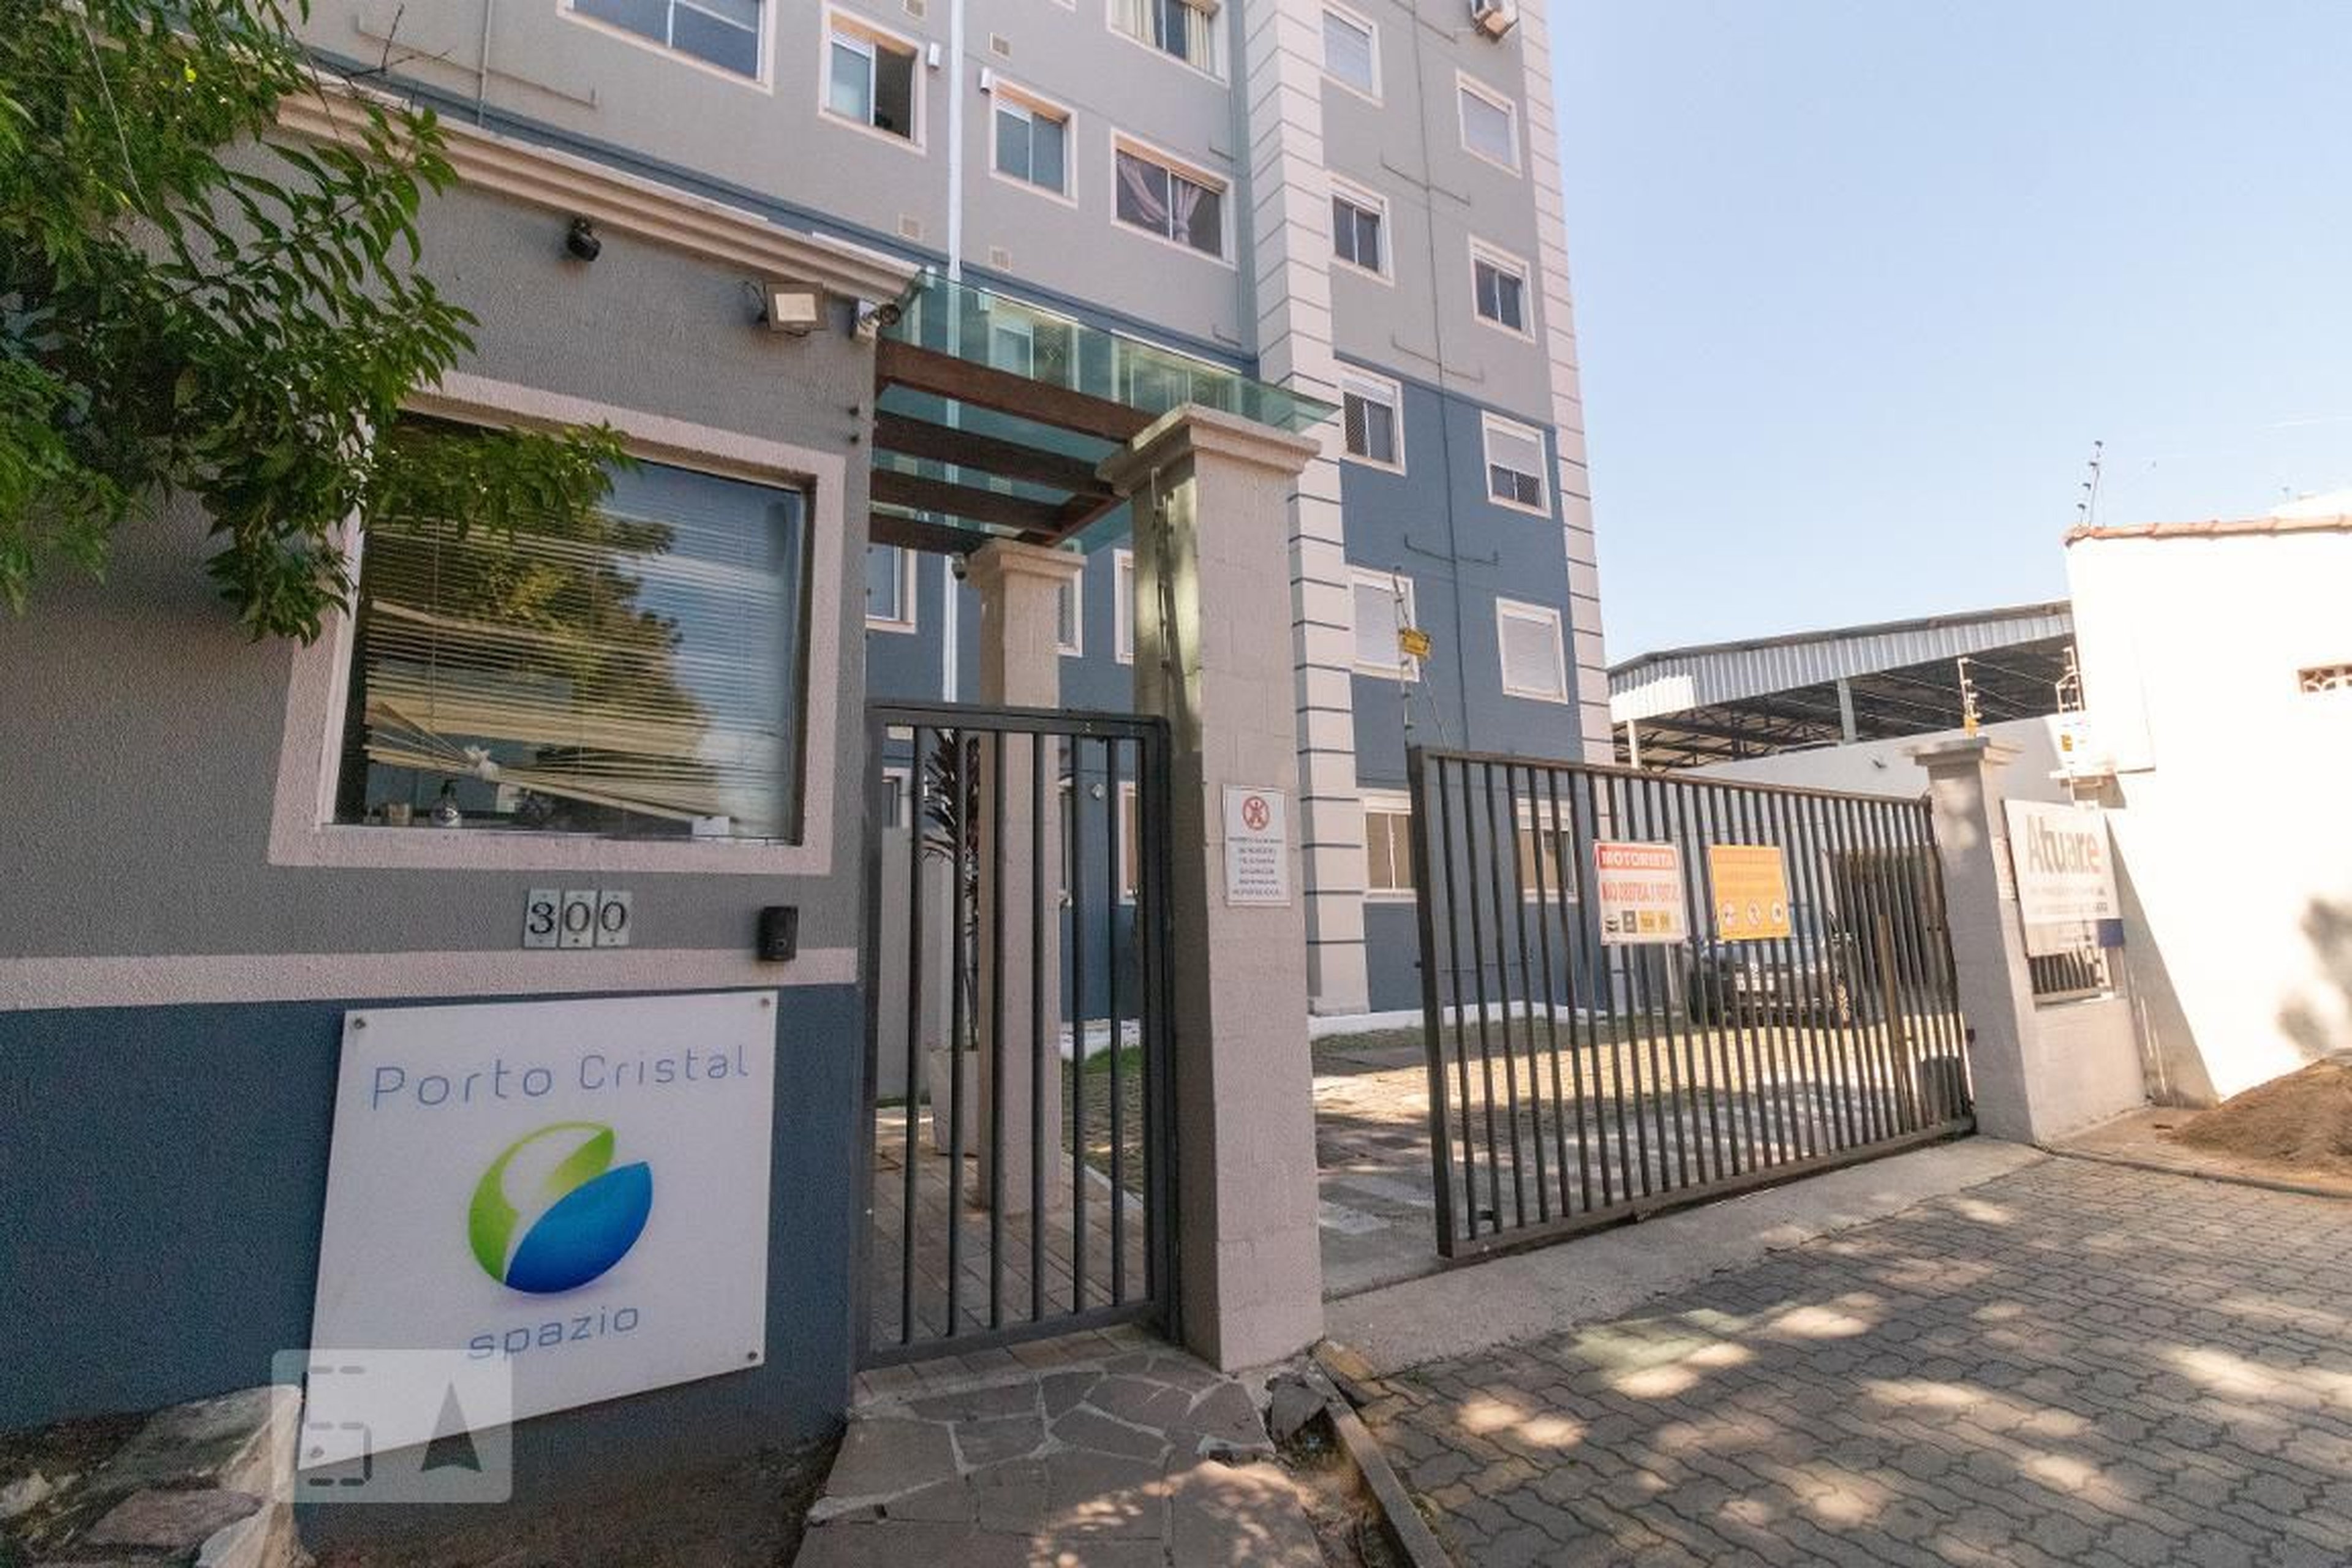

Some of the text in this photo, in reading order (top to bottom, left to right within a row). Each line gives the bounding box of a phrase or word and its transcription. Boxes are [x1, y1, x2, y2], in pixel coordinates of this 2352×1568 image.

[529, 902, 626, 934] 300
[372, 1045, 748, 1111] Porto Cristal
[469, 1306, 638, 1360] spazio
